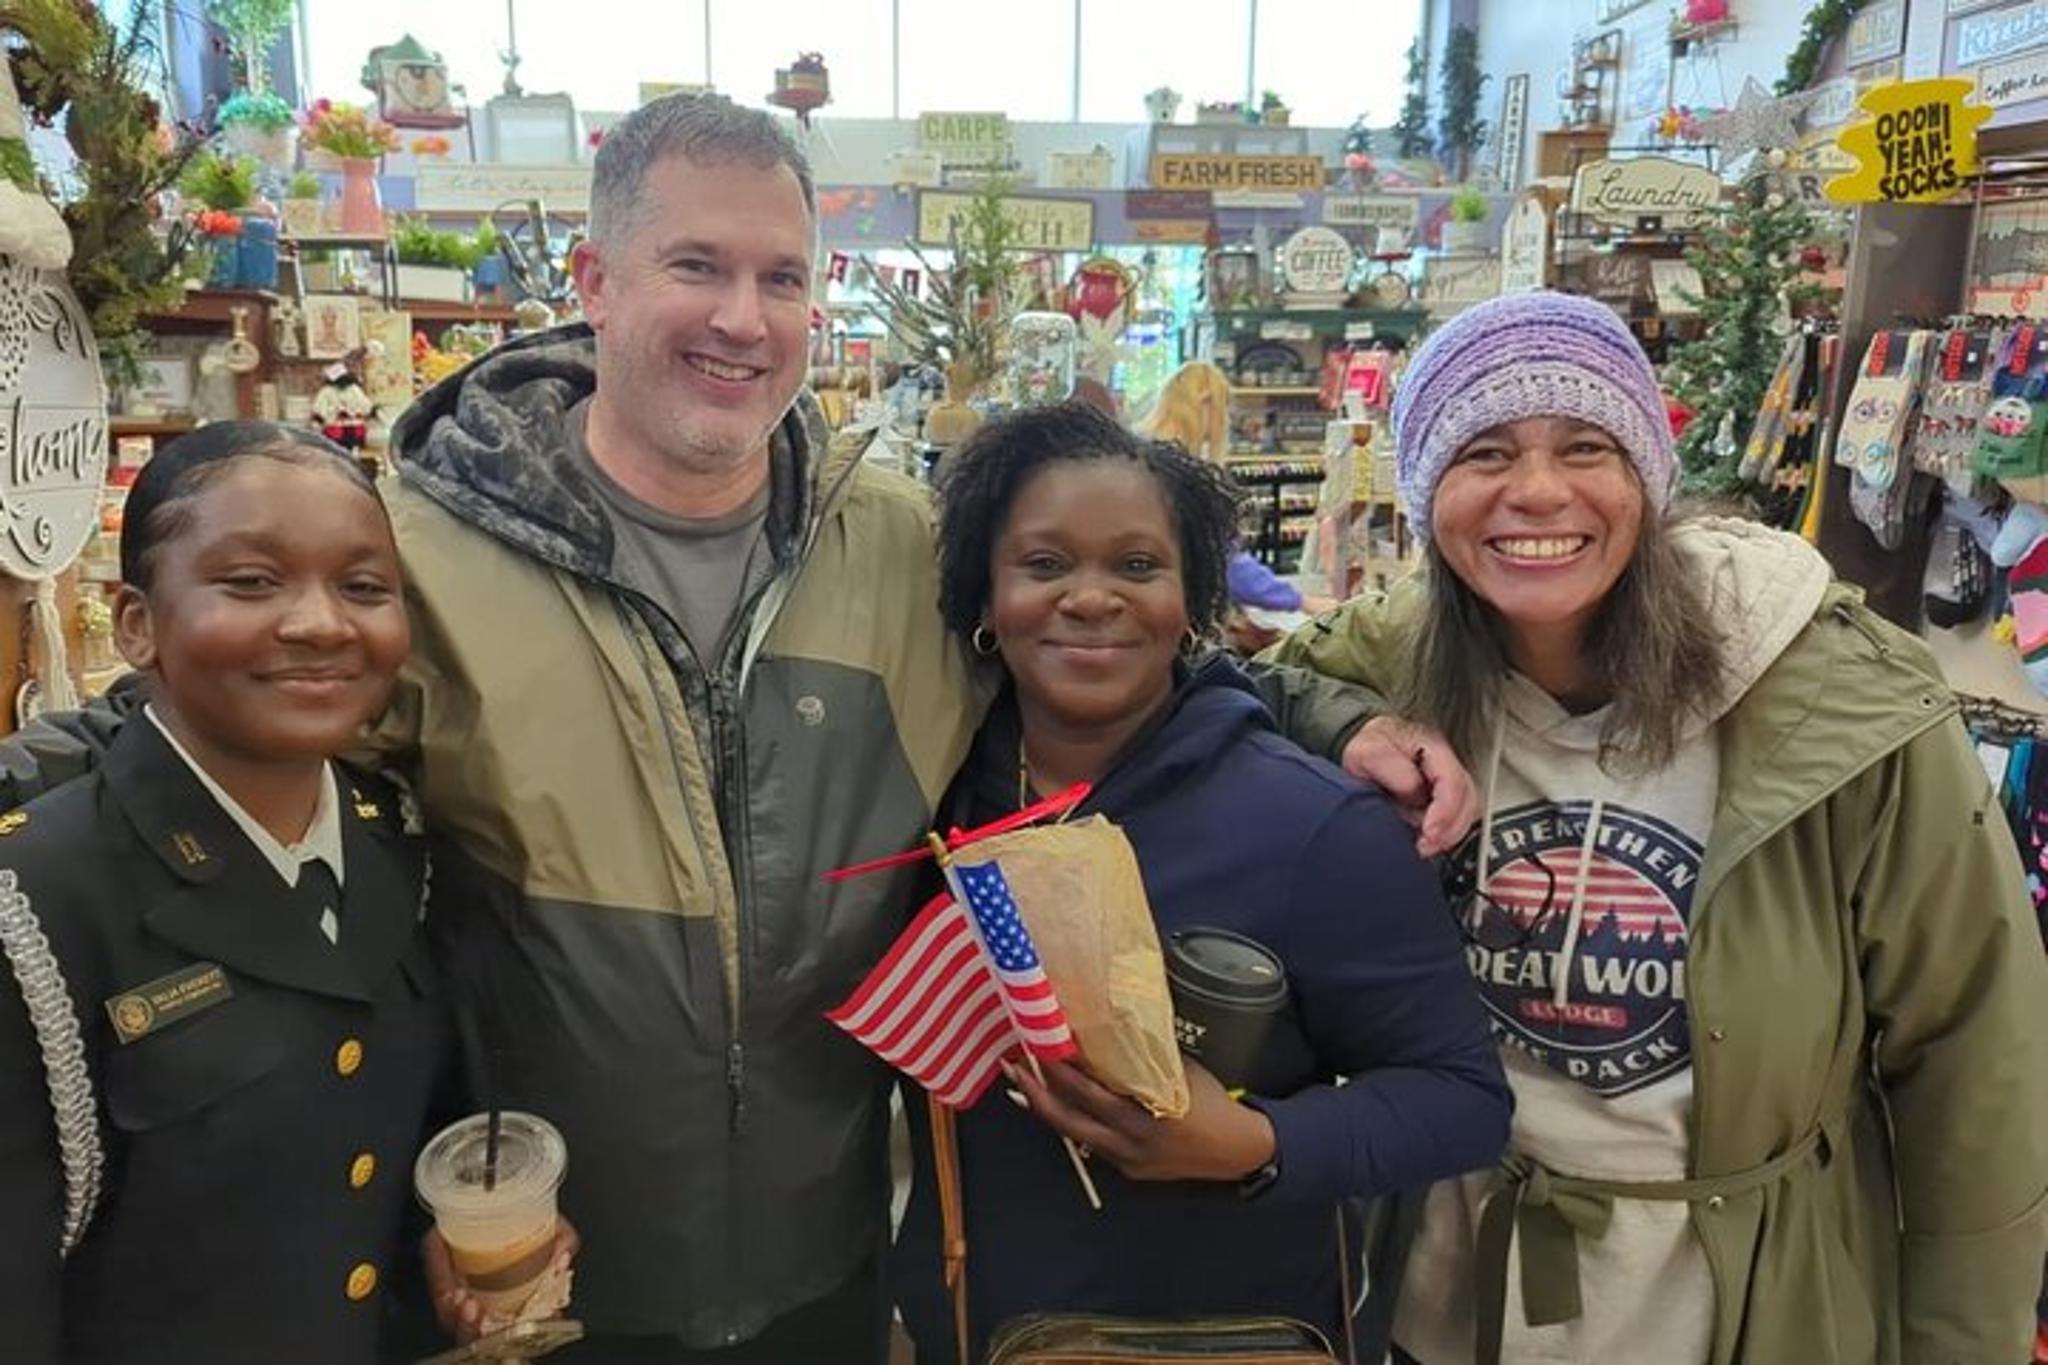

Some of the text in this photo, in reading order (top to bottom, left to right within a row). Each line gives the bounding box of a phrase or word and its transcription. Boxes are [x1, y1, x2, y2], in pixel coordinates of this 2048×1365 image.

[926, 117, 1004, 141] CARPE
[1163, 160, 1316, 187] FARM FRESH
[1878, 158, 1957, 202] SOCKS
[1586, 167, 1711, 225] Laundry
[1291, 249, 1345, 273] COFFEE
[1466, 944, 1567, 989] REAT
